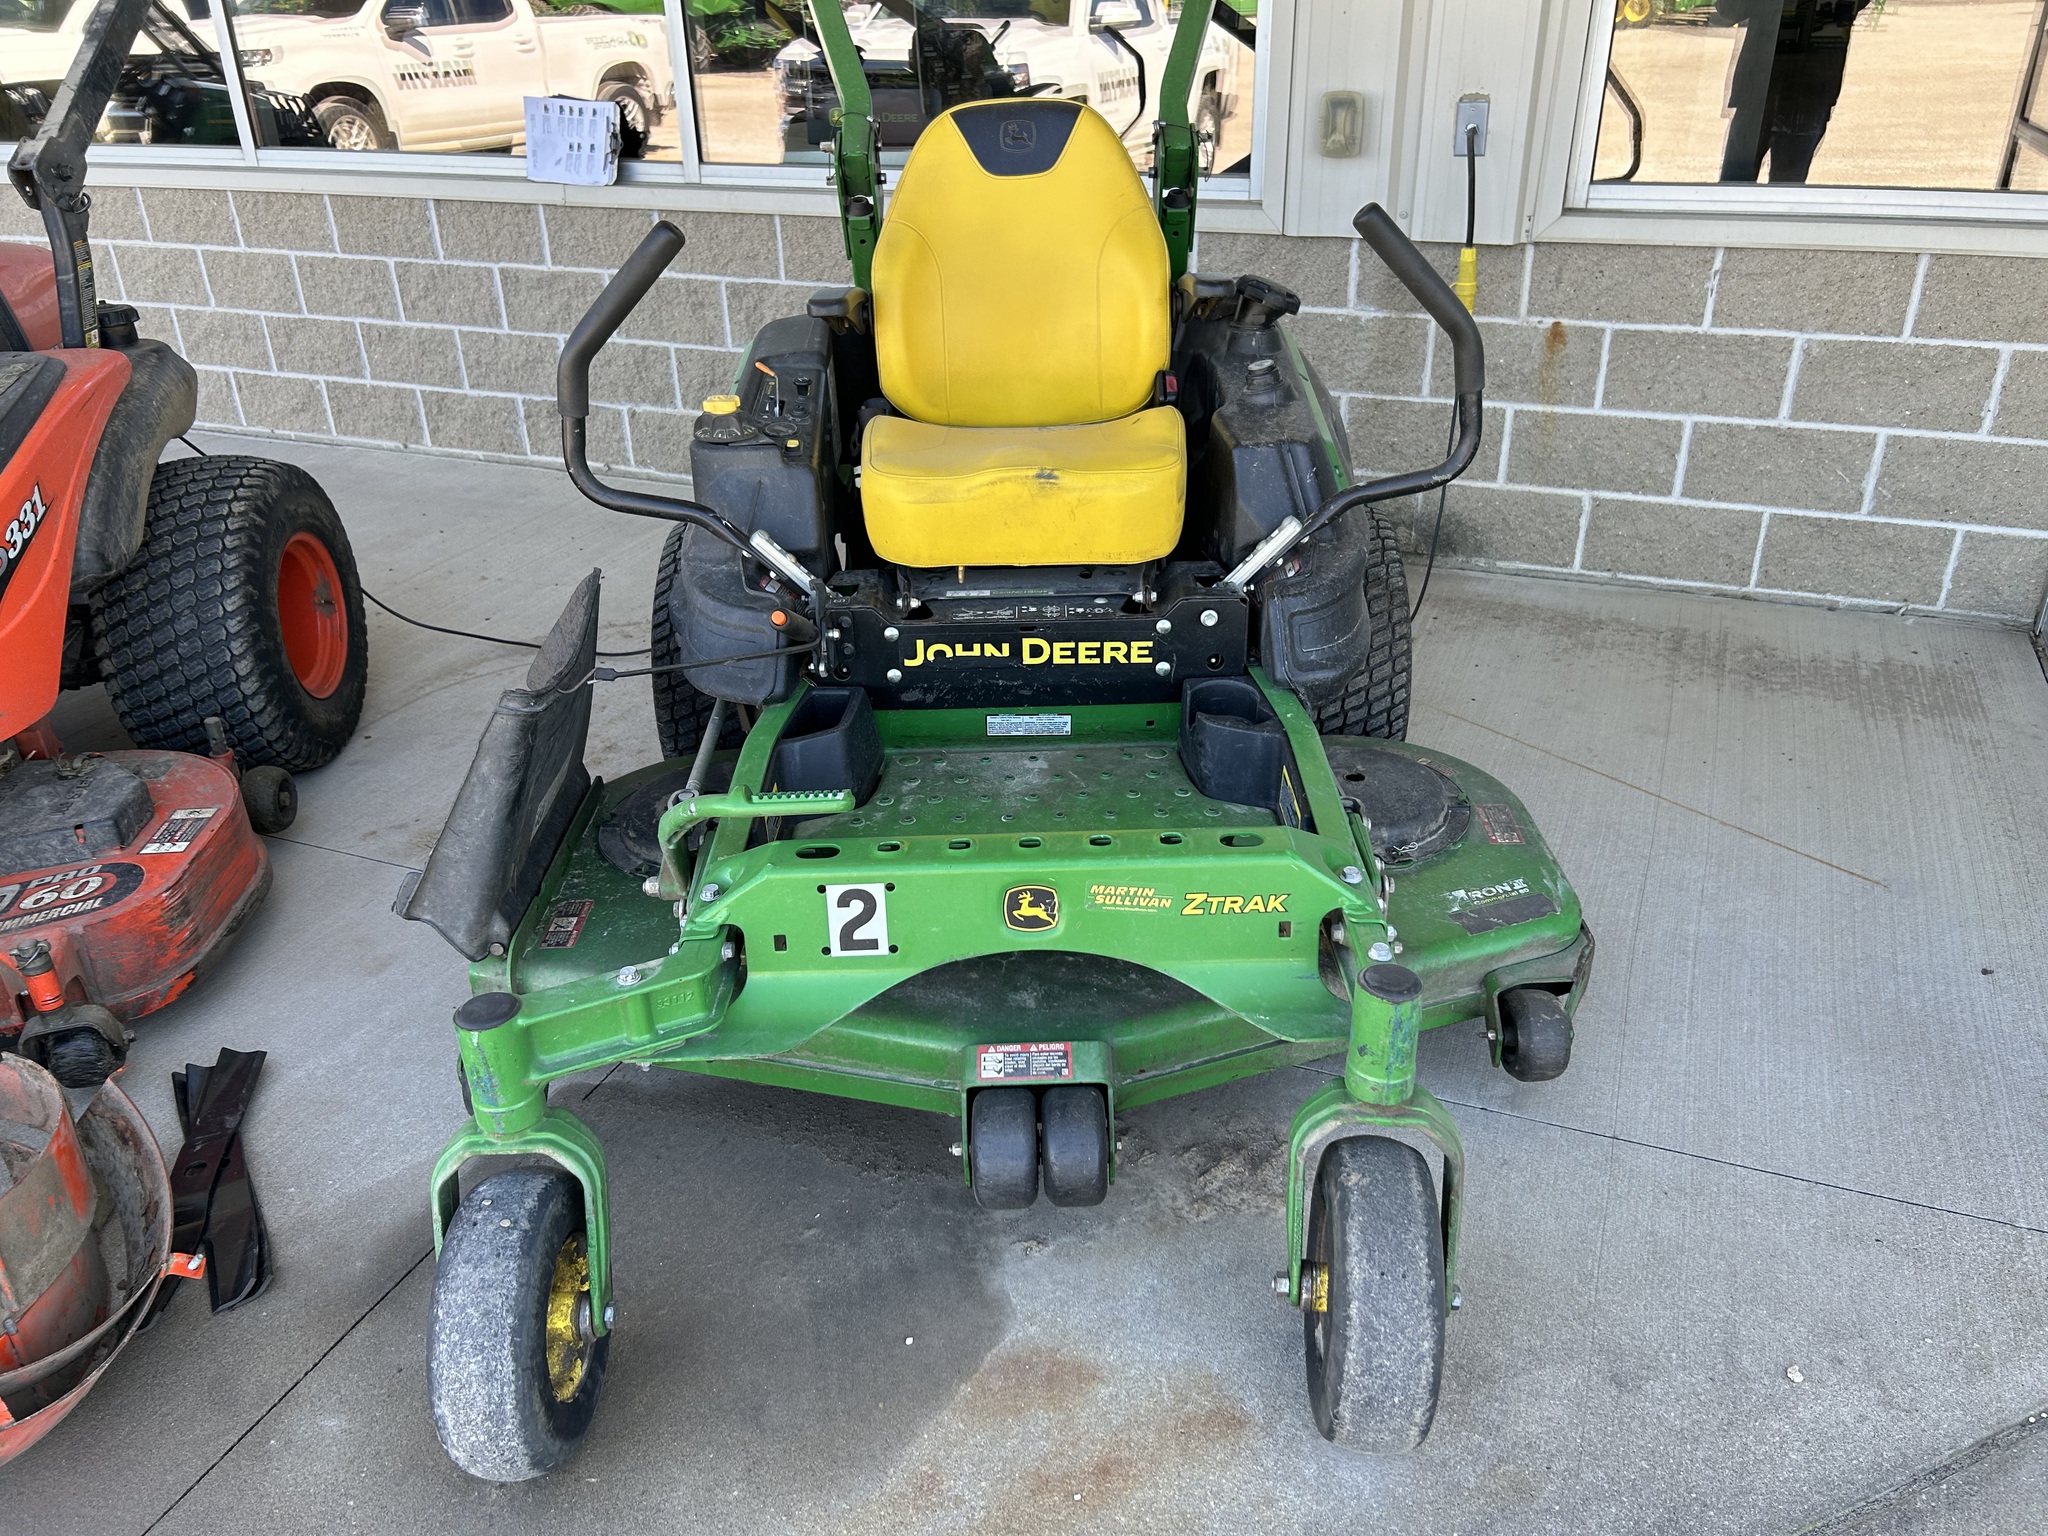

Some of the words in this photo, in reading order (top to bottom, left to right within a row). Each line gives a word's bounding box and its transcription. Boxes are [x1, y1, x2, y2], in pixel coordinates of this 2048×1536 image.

[881, 112, 919, 123] DEERE
[904, 638, 1010, 667] JOHN
[1022, 637, 1153, 665] DEERE
[26, 864, 103, 890] PRO
[19, 876, 103, 910] 60
[1090, 885, 1155, 897] MARTIN
[1094, 895, 1172, 908] SULLIVAN
[1181, 892, 1291, 915] ZTRAK
[837, 888, 879, 951] 2
[996, 1044, 1022, 1052] DANGER
[1038, 1043, 1065, 1051] PELIGRO
